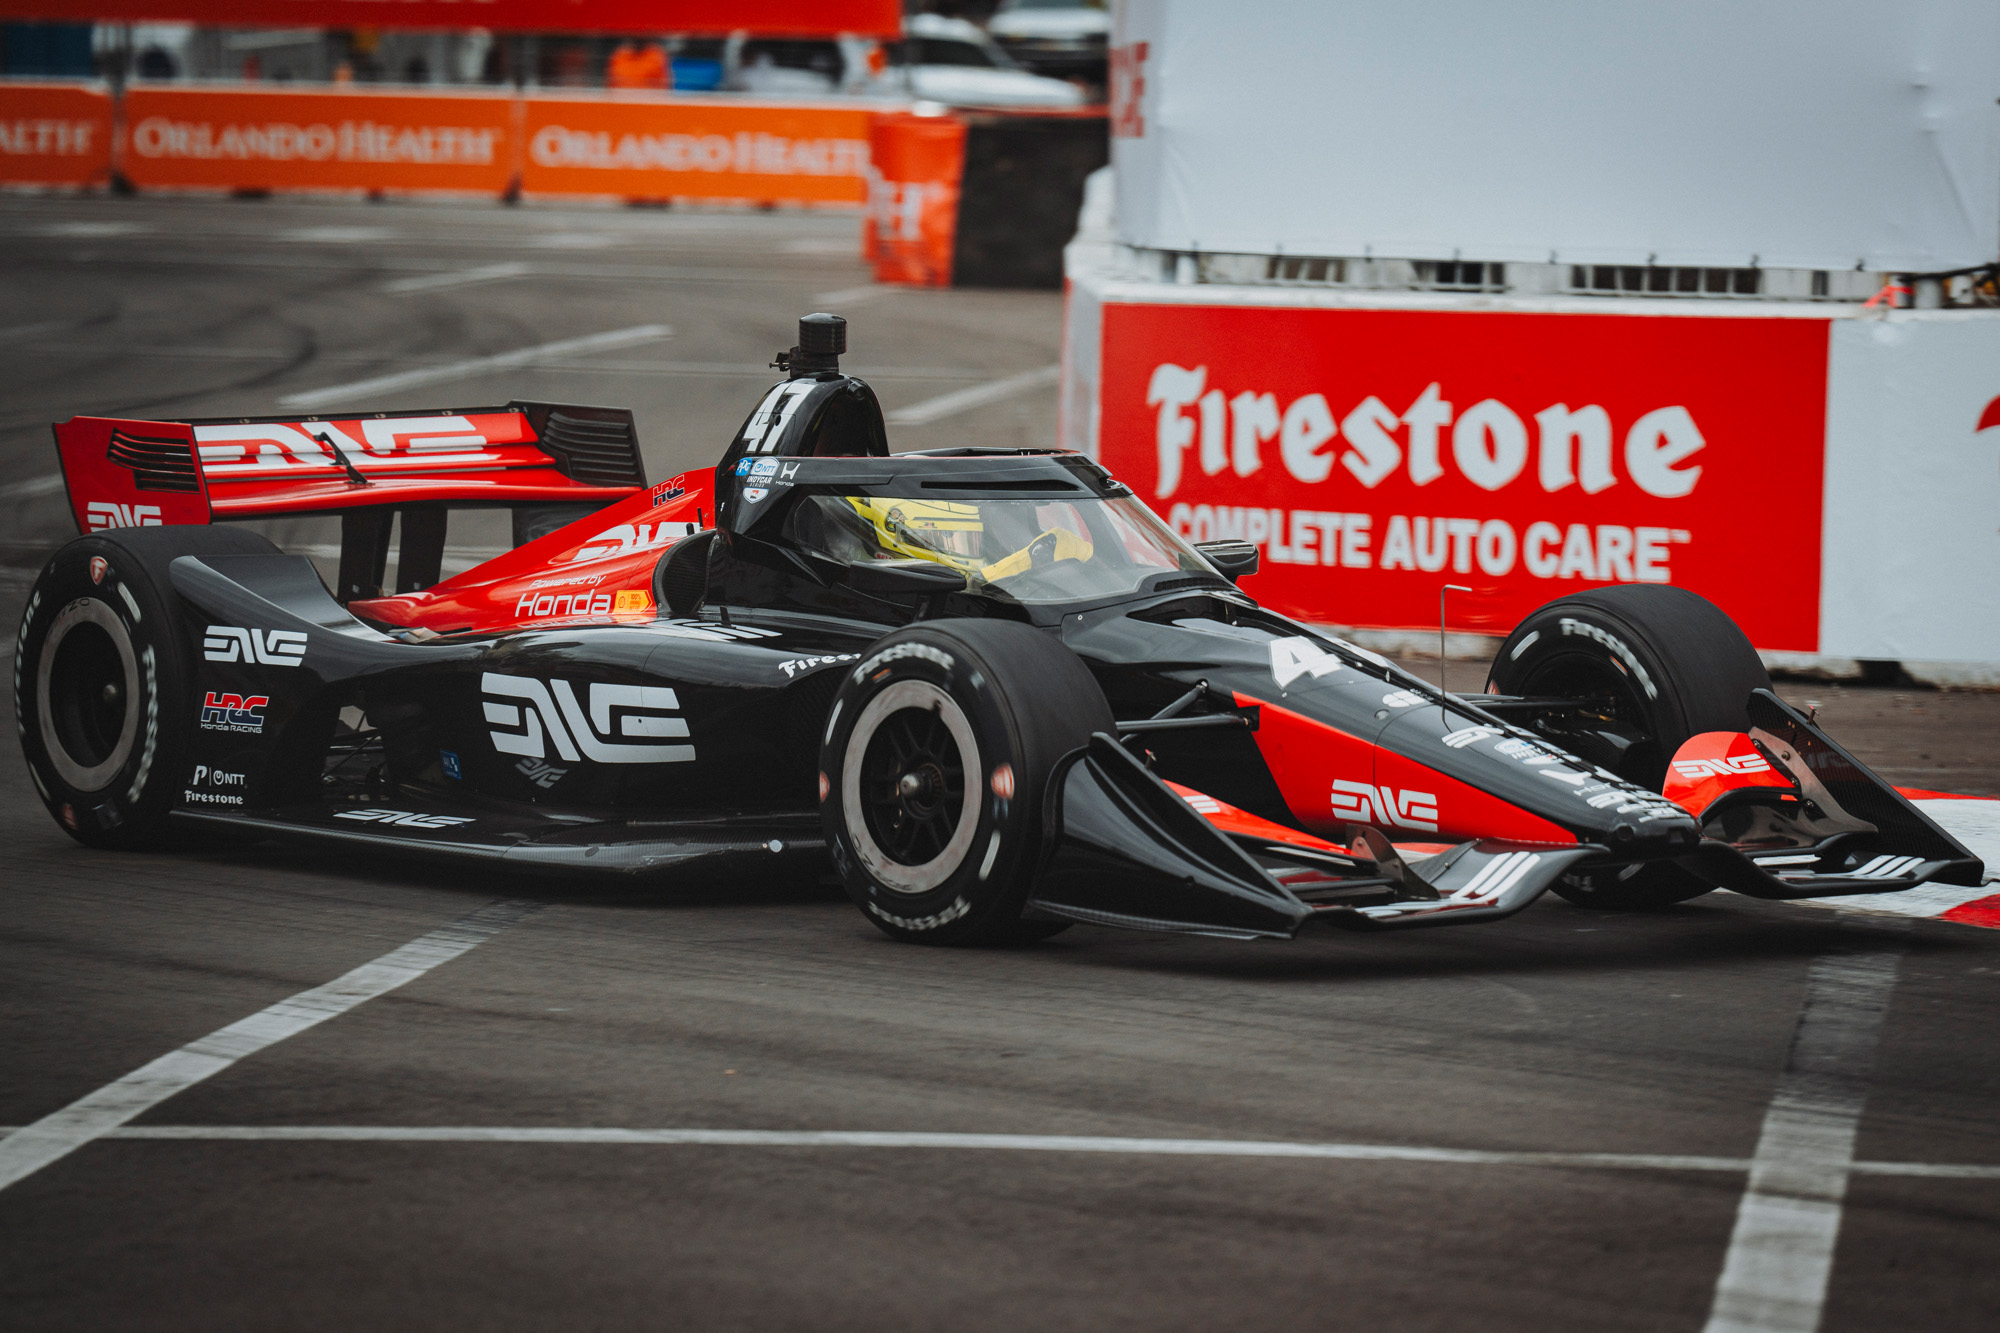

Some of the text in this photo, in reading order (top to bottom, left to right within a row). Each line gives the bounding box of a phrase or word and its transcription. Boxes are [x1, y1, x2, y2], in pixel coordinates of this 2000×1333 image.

[1146, 362, 1707, 500] Firestone
[1169, 502, 1373, 568] COMPLETE
[1379, 515, 1518, 577] AUTO
[529, 575, 607, 590] Powered by
[515, 588, 612, 617] Honda
[201, 691, 269, 727] HRC
[201, 722, 263, 734] Honda RACING
[184, 790, 244, 805] Firestone
